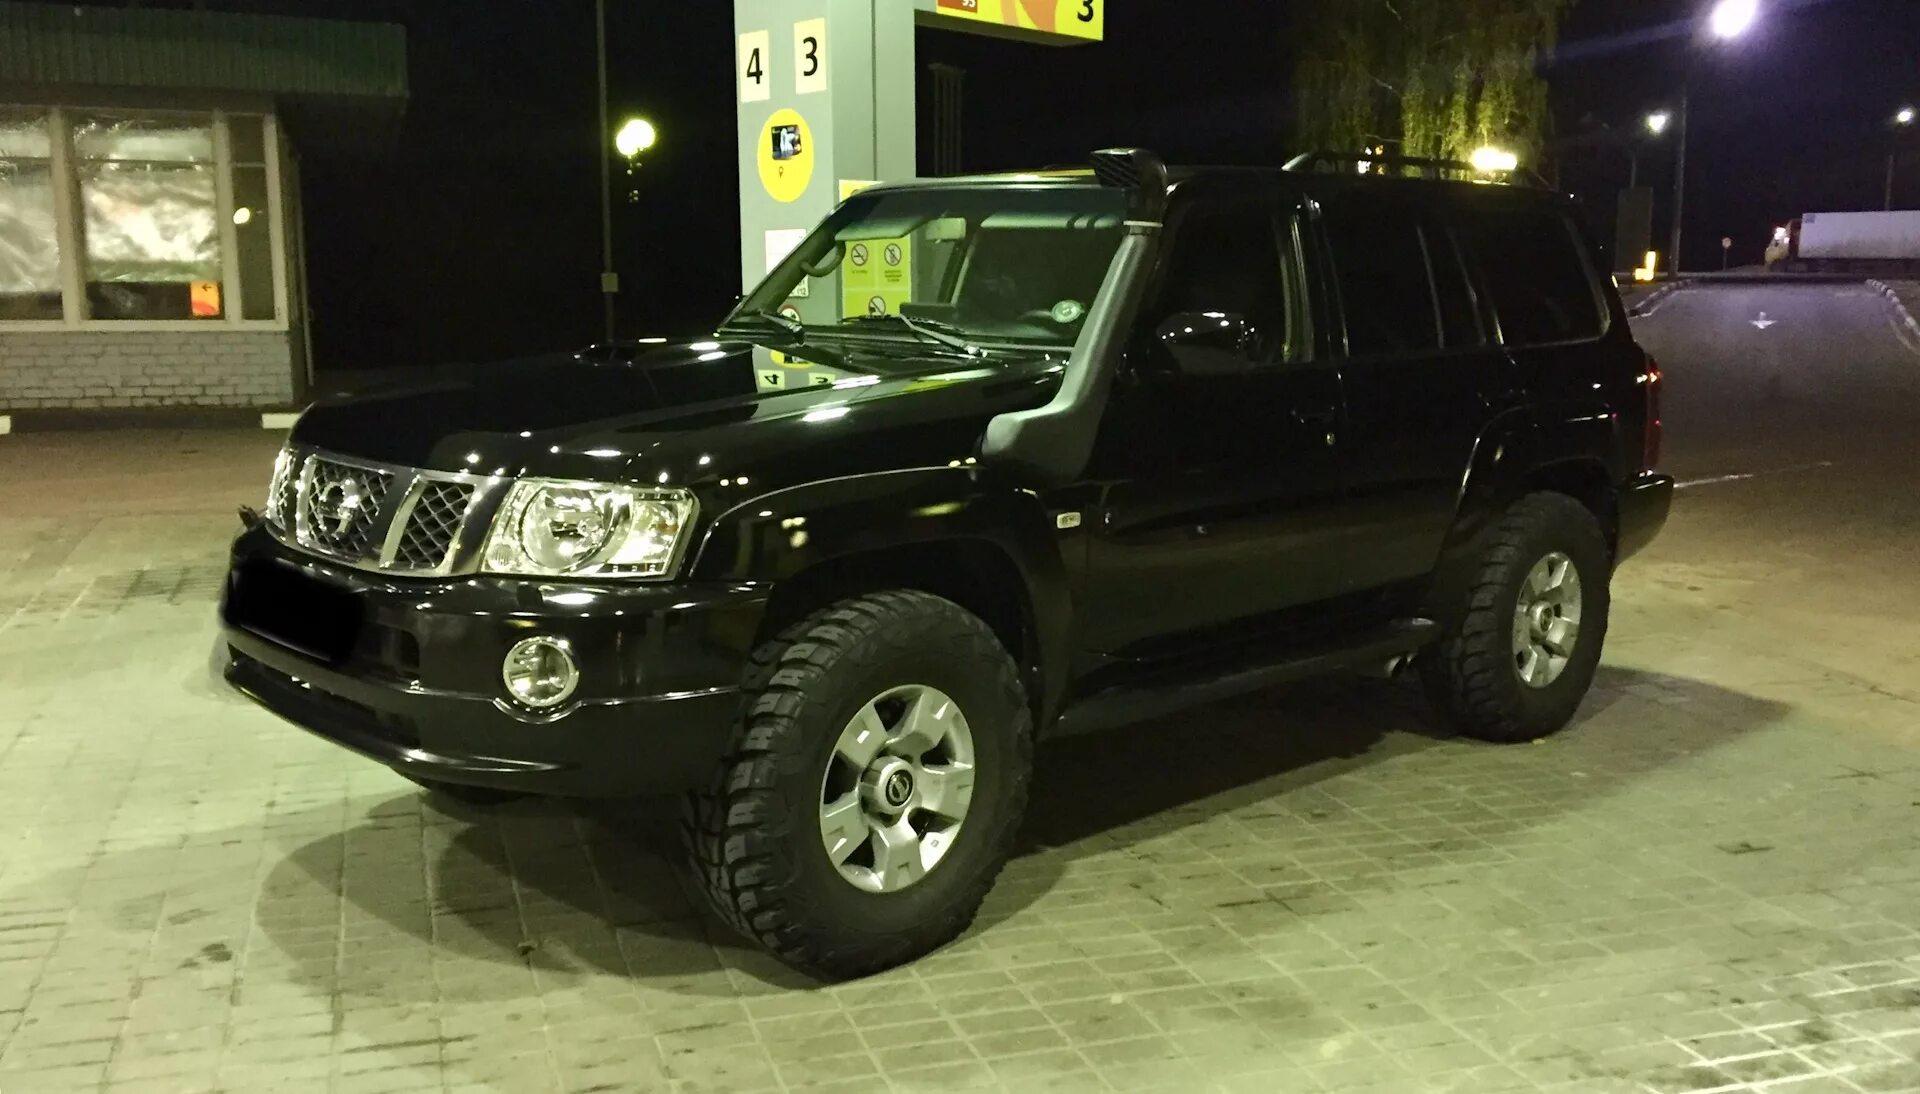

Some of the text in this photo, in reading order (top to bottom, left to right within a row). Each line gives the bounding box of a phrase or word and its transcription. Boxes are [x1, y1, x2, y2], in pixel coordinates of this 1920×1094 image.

[1077, 0, 1094, 23] 3
[746, 48, 763, 85] 4
[803, 36, 818, 77] 3
